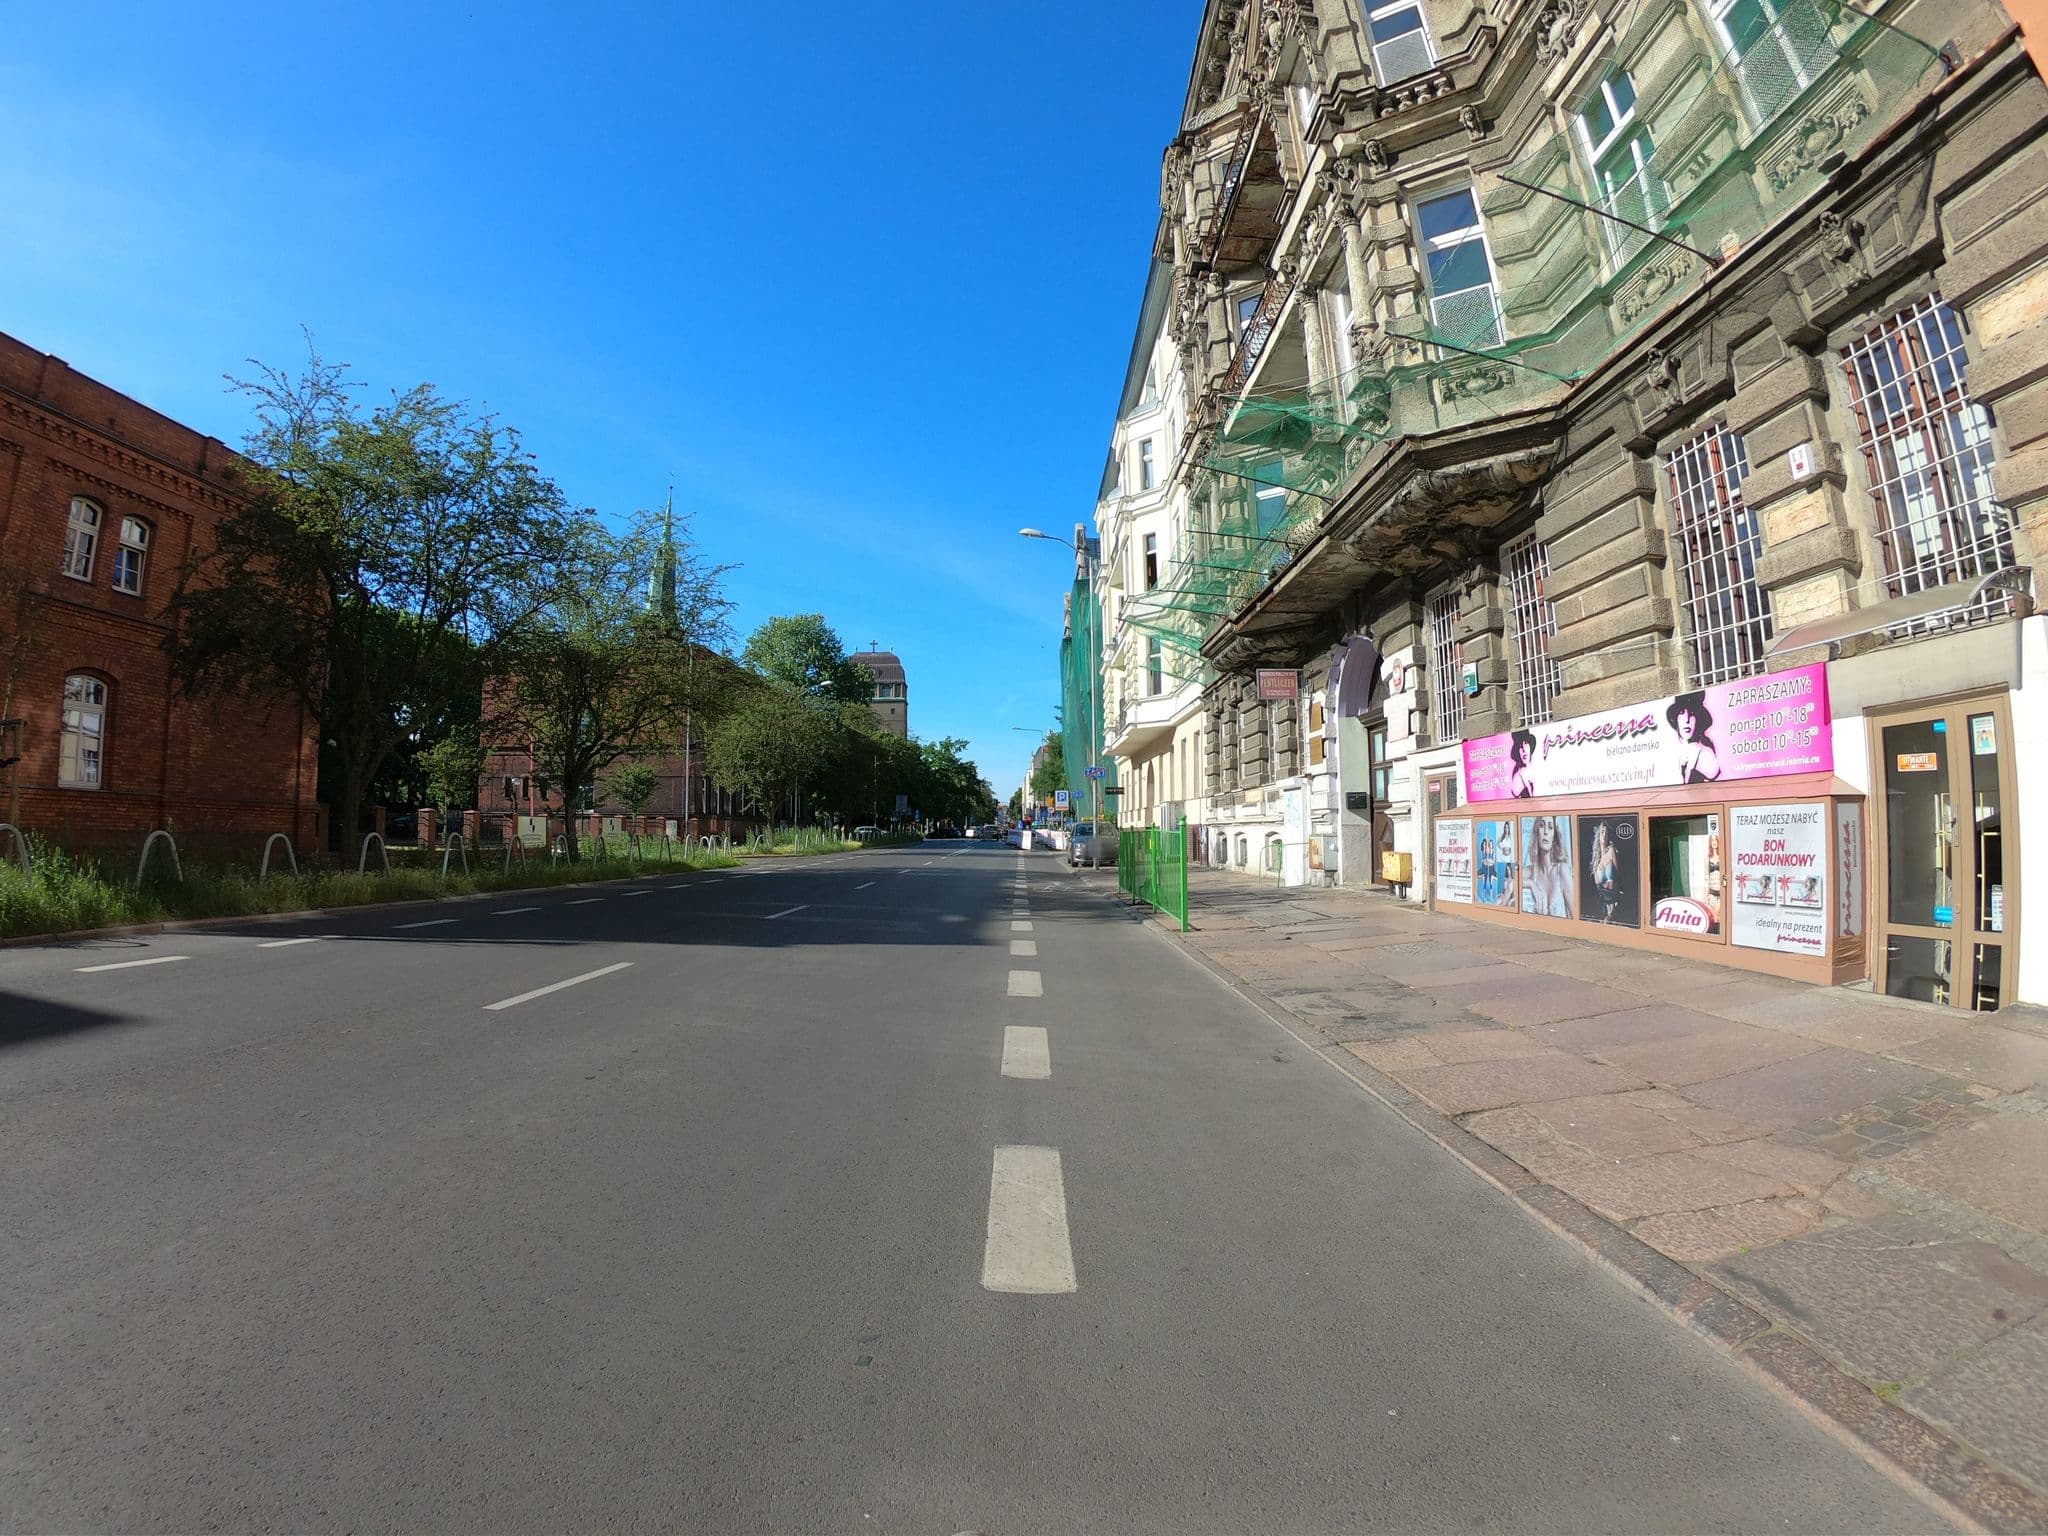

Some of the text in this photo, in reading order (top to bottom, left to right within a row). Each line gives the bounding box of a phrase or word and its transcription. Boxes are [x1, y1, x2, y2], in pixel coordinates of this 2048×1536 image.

[1730, 716, 1766, 736] pon-pt
[1543, 714, 1657, 759] princessa
[1606, 741, 1660, 757] bielizna damska
[1732, 738, 1769, 755] sobota
[1736, 815, 1758, 826] TERAZ
[1791, 811, 1818, 824] NABYĆ
[1763, 840, 1786, 852] BON
[1737, 853, 1816, 867] PODARUNKOWY
[1843, 820, 1856, 937] princessa
[1656, 906, 1702, 927] Anita
[1755, 917, 1822, 934] idealny na prezent
[1776, 933, 1822, 946] princessa
